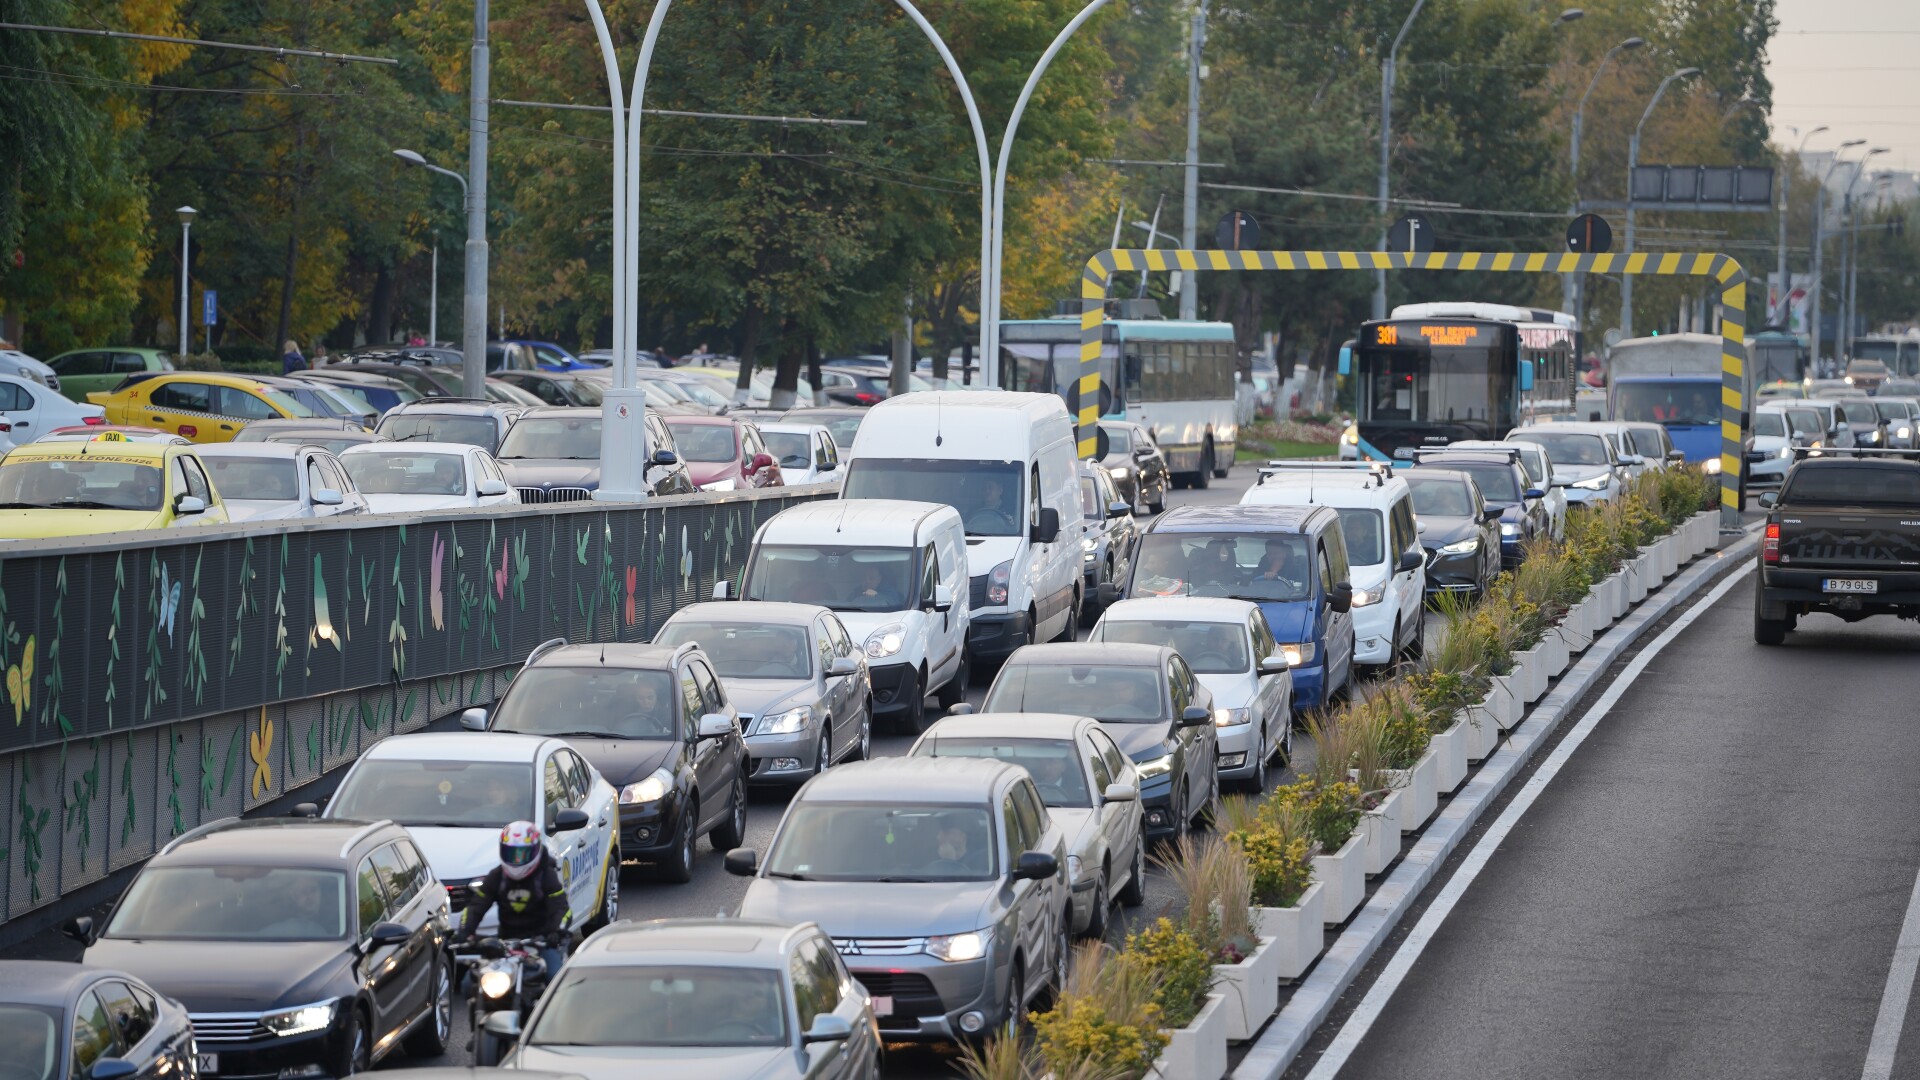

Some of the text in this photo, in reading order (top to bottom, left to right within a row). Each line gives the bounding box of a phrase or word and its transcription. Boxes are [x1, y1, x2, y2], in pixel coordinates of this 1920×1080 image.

[105, 433, 120, 441] TAXI
[1797, 544, 1899, 560] HILUX
[1830, 581, 1873, 589] B 79 GLS
